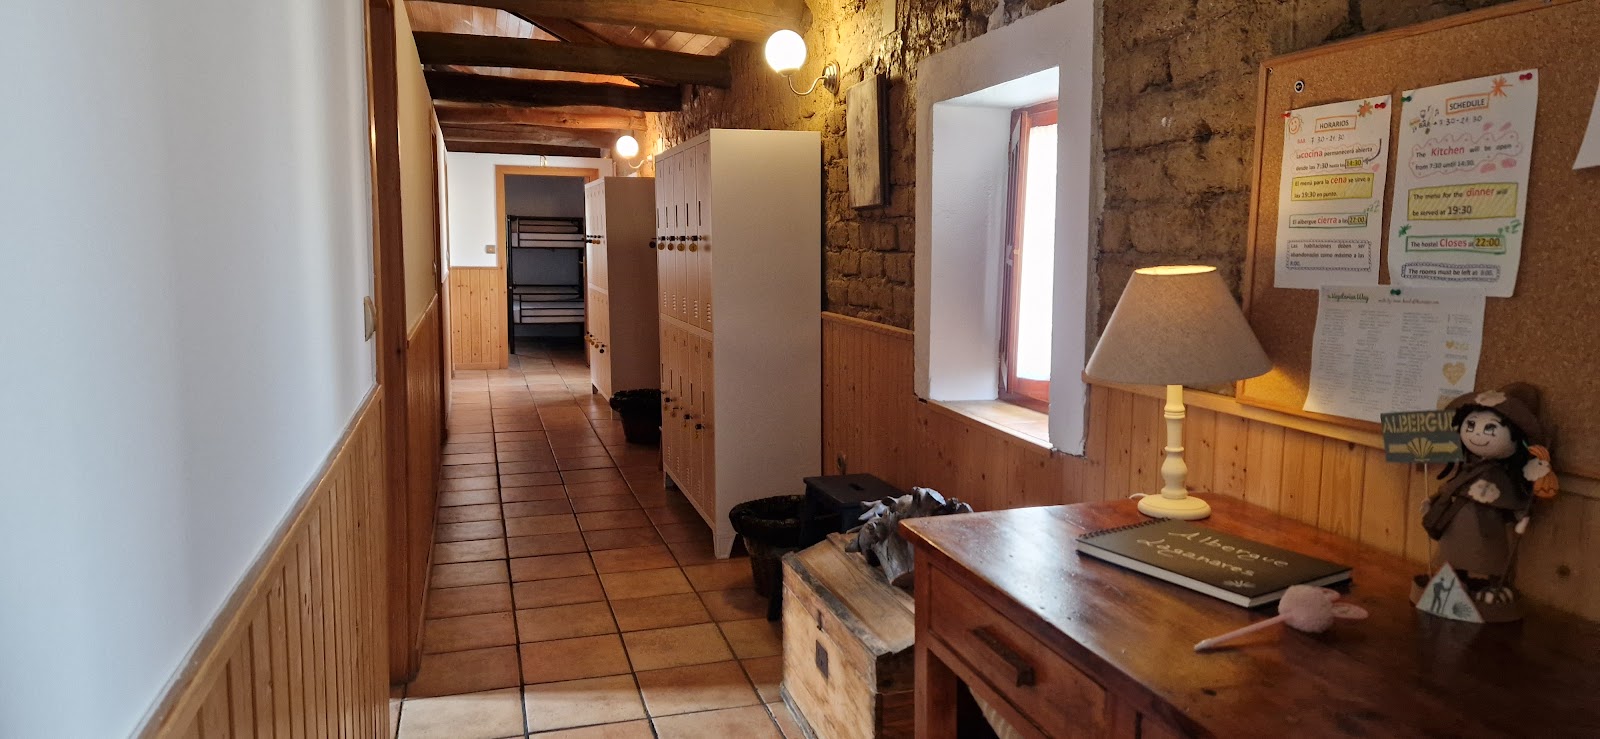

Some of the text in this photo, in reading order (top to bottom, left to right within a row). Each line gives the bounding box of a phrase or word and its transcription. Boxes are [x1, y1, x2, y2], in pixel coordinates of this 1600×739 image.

[1449, 98, 1486, 110] SCHEDULE
[1319, 120, 1350, 129] HORARIOS
[1301, 150, 1323, 159] cocina
[1324, 149, 1355, 157] permanecerá
[1431, 147, 1465, 156] Kitchen
[1496, 144, 1512, 152] open
[1346, 159, 1362, 167] 14:30
[1443, 161, 1457, 169] until
[1331, 176, 1347, 184] cena
[1466, 187, 1495, 197] dinner
[1448, 206, 1472, 215] 19:30
[1318, 216, 1338, 224] cierra
[1440, 238, 1467, 248] Closes
[1461, 268, 1471, 276] left
[1357, 293, 1369, 304] Way
[1168, 532, 1289, 567] Albergue
